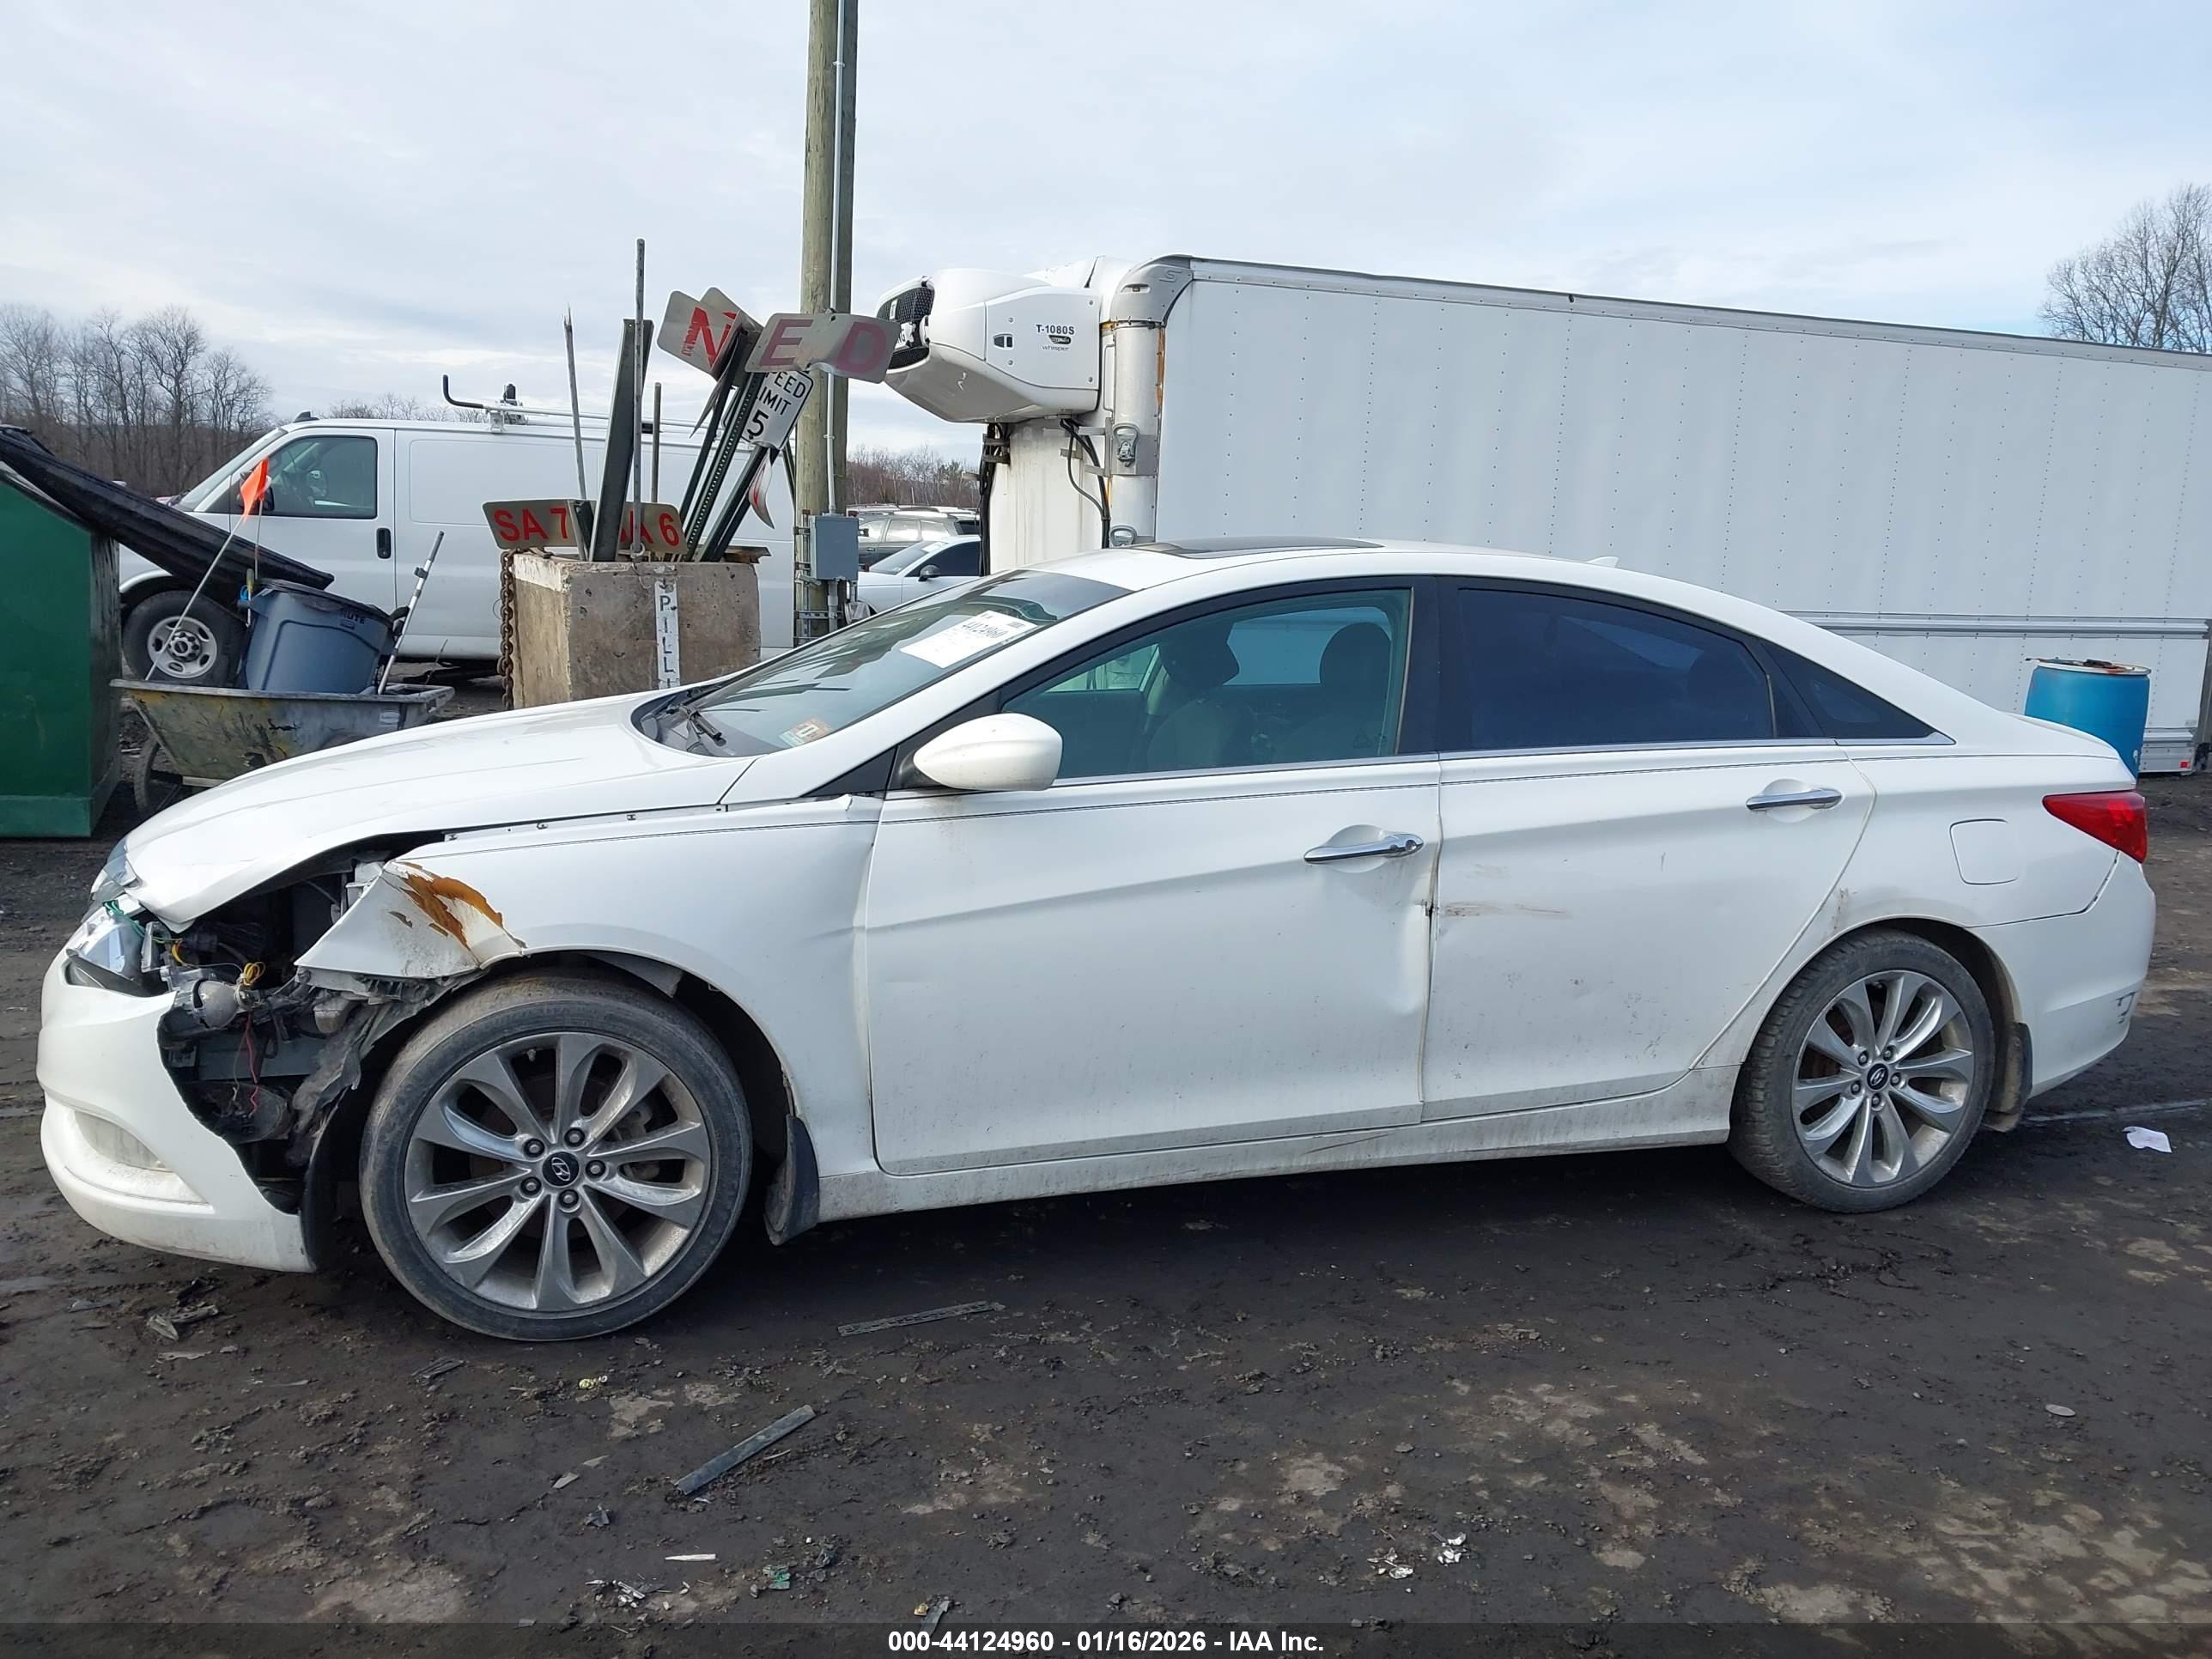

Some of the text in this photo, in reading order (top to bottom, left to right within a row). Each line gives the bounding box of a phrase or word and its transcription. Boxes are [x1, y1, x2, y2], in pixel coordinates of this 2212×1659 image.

[1036, 324, 1075, 335] T-1080S
[757, 386, 792, 415] IMIT
[494, 507, 568, 542] SA 7
[659, 513, 679, 546] 6
